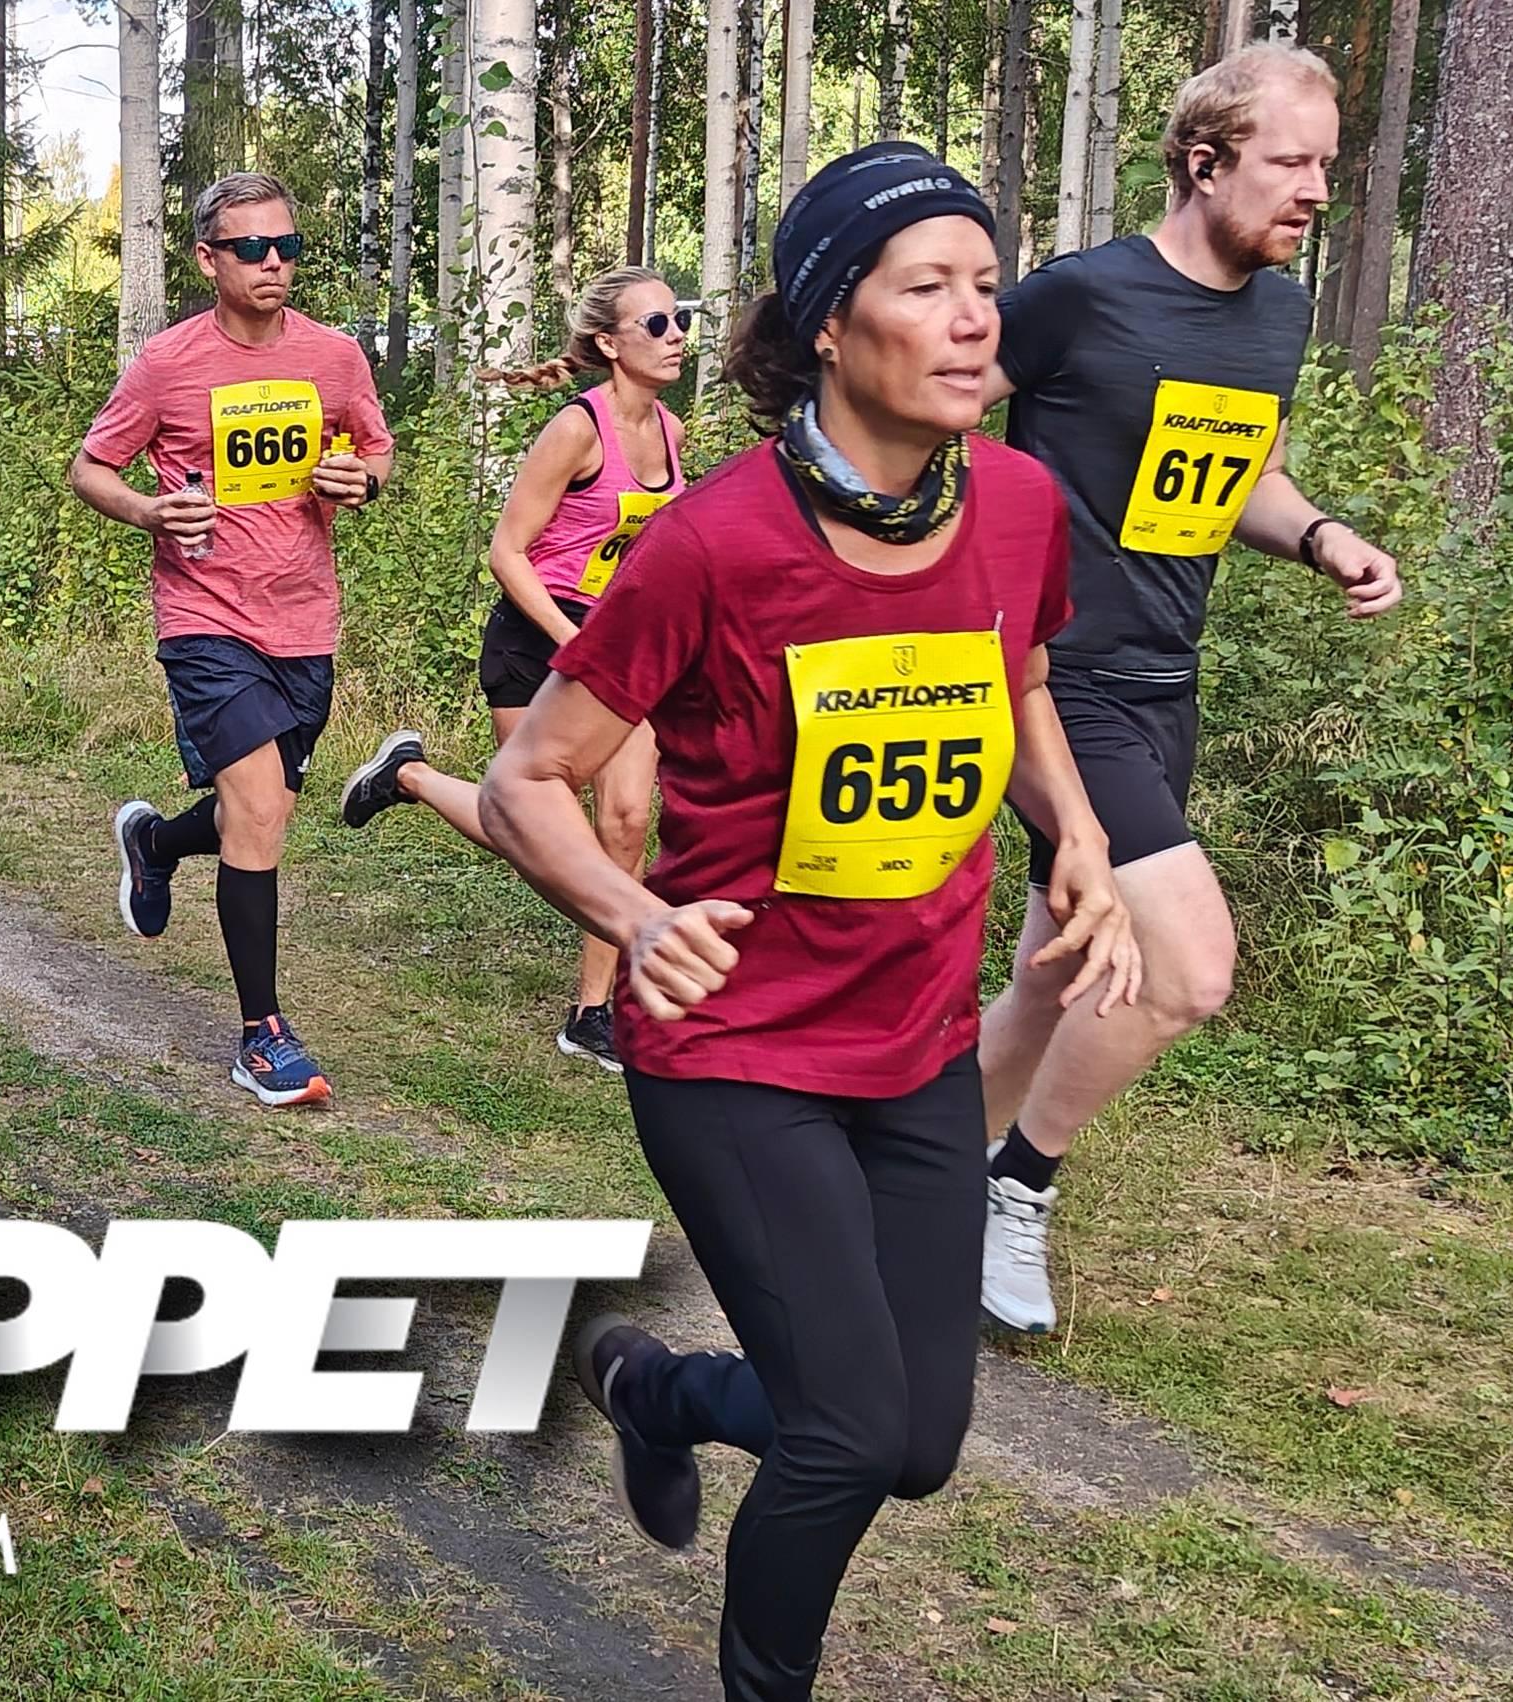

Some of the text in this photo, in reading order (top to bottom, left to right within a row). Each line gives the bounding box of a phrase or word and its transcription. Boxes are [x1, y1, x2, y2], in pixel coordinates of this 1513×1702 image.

[220, 400, 311, 416] KRAFTLOPPET
[1162, 413, 1268, 439] KRAFTLOPPET
[226, 424, 308, 469] 666
[1152, 448, 1252, 507] 617
[814, 682, 993, 713] KRAFTLOPPET
[819, 737, 983, 825] 655
